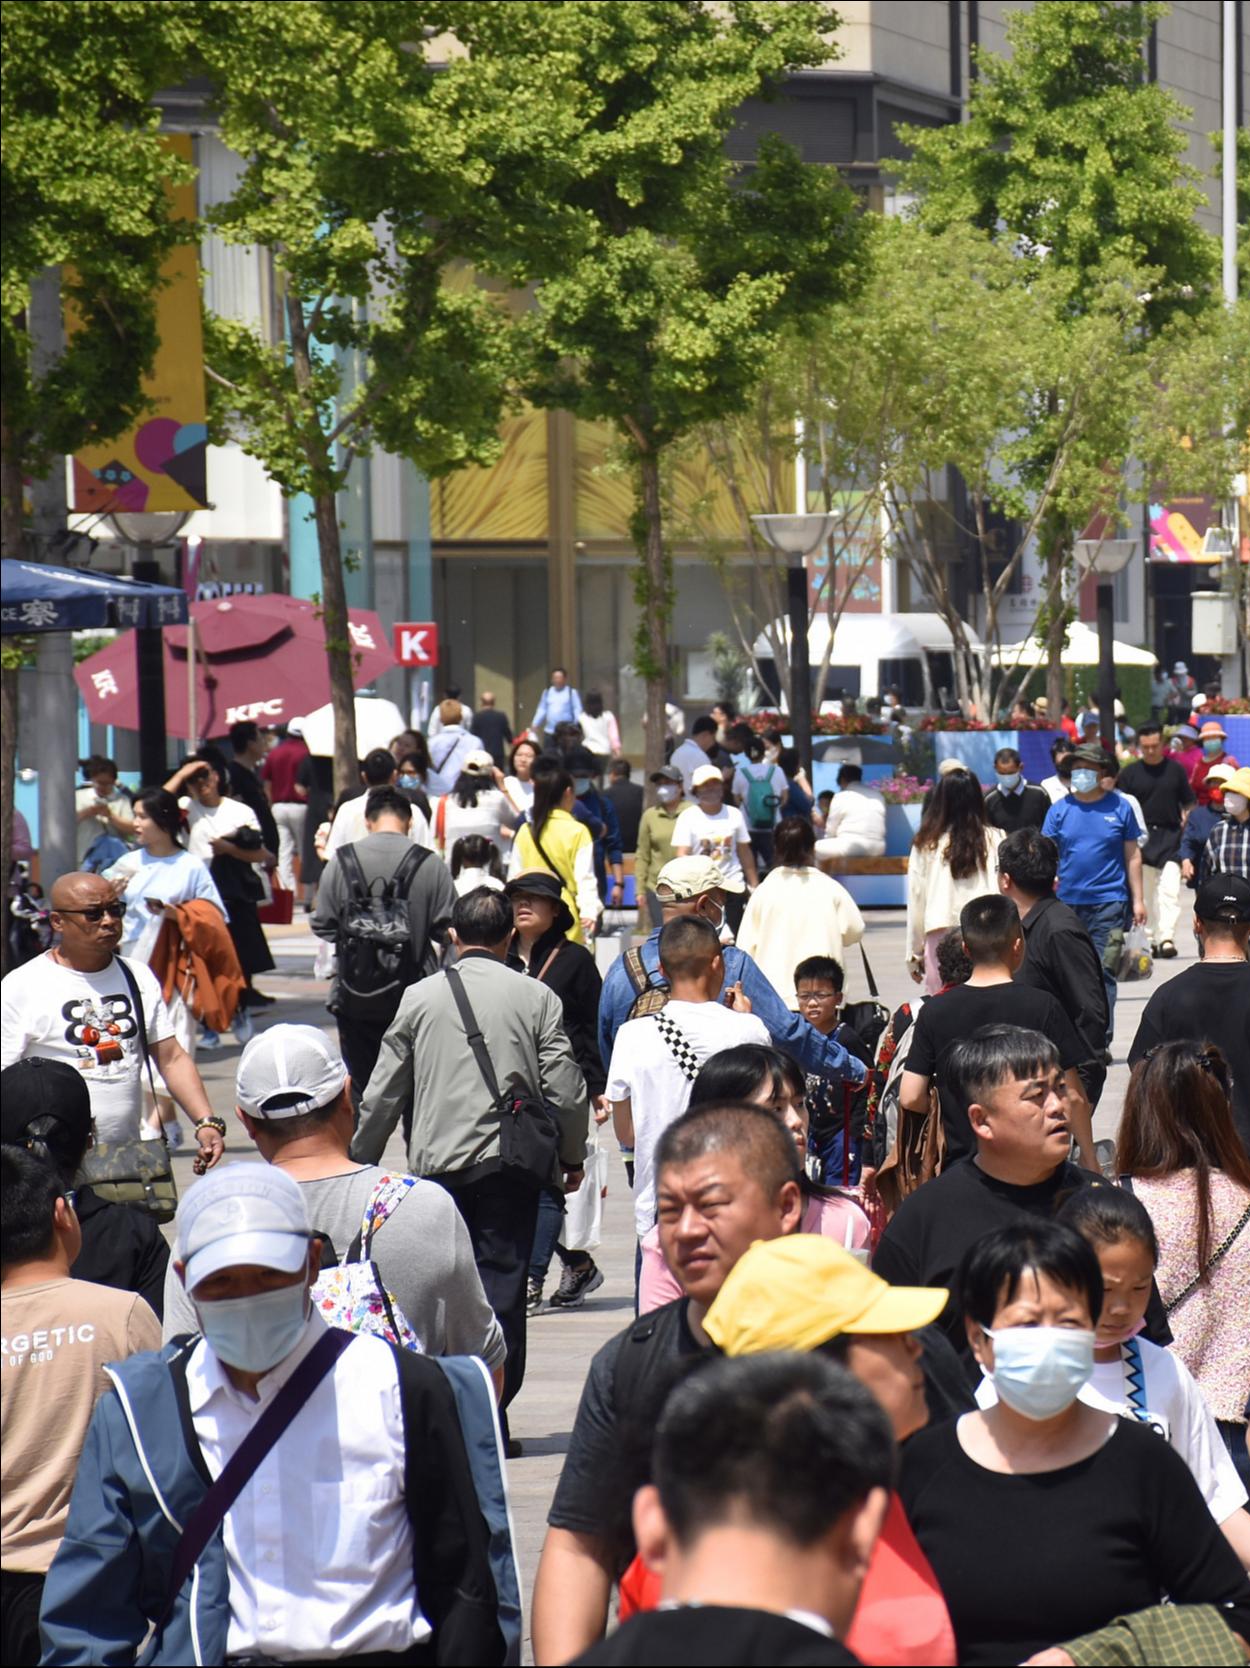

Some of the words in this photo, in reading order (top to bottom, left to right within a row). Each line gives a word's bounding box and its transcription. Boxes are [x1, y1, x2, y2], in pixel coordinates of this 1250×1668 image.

[19, 599, 59, 626] 察
[401, 630, 429, 661] K
[91, 668, 119, 699] KFC
[226, 699, 284, 724] KFC
